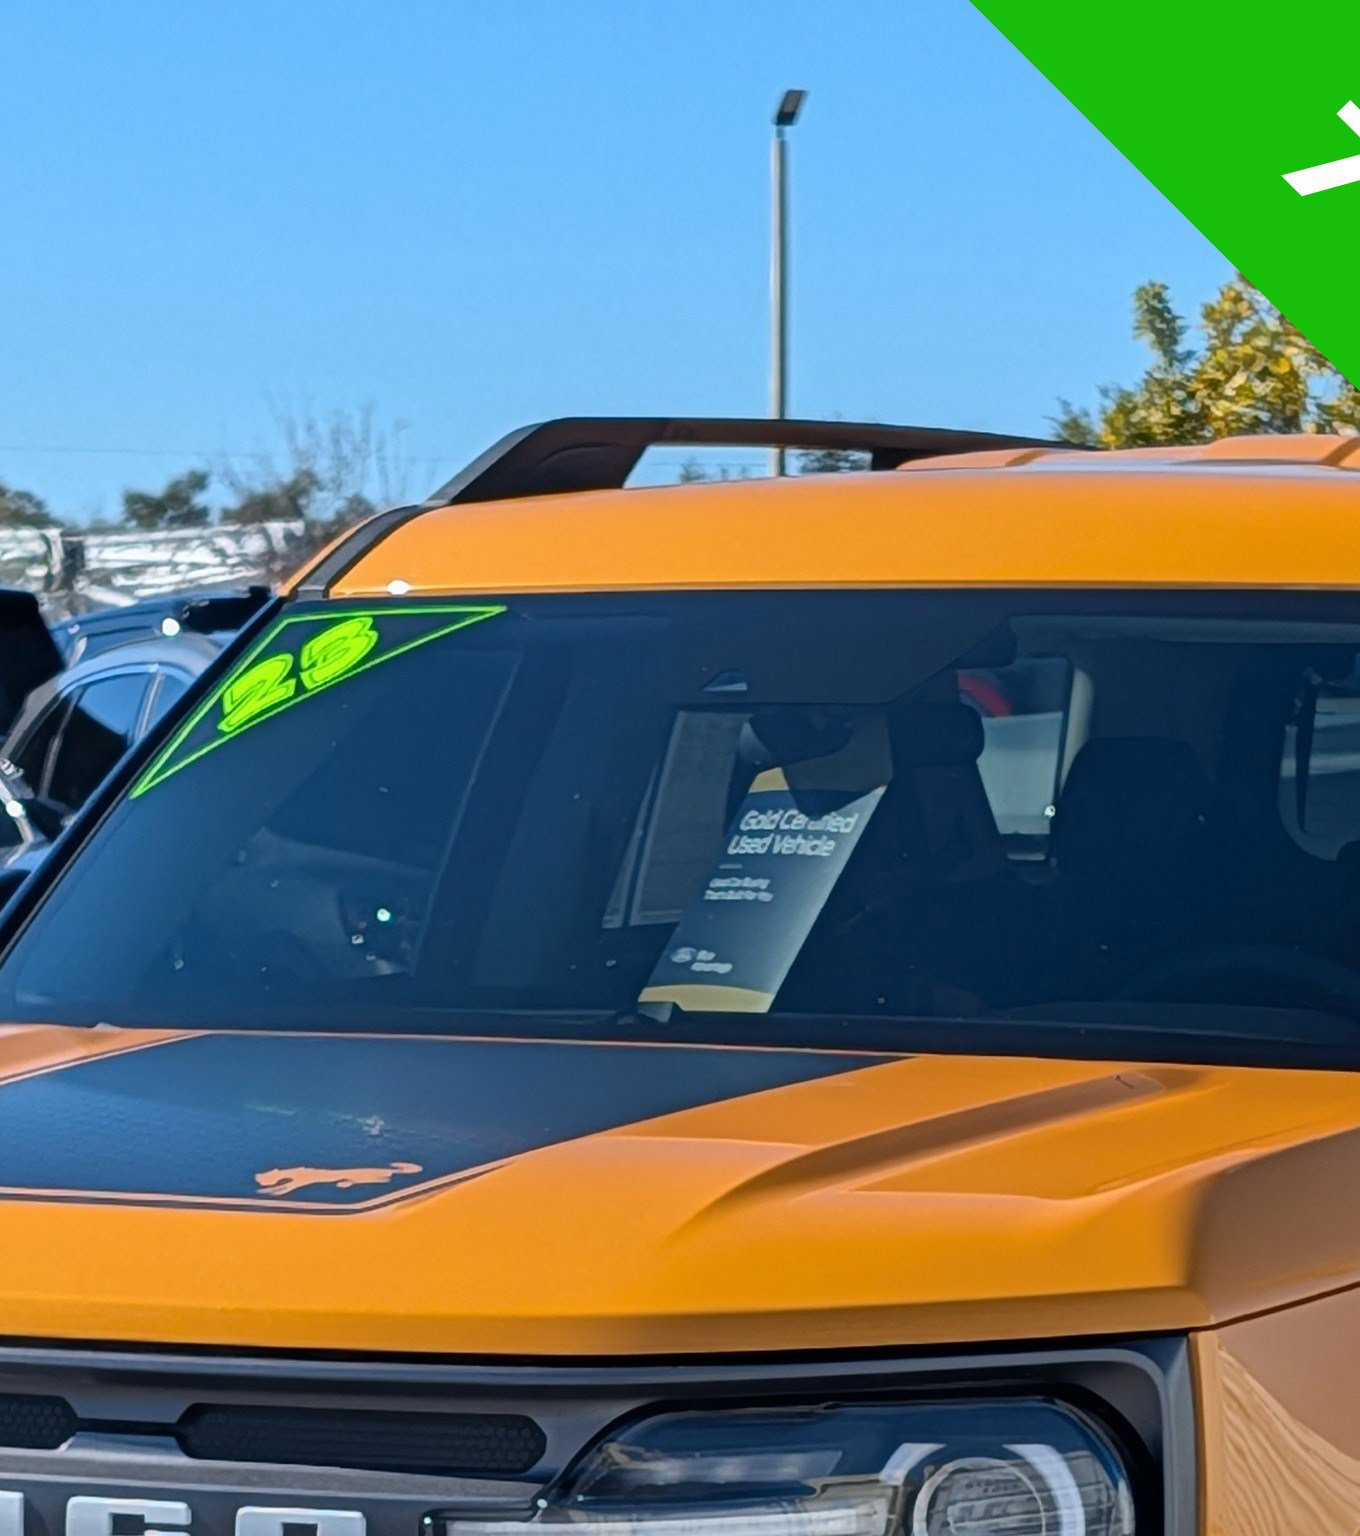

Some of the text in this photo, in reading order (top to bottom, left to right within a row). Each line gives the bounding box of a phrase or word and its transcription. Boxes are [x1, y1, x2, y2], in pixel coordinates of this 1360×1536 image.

[740, 809, 784, 831] Gold
[727, 833, 836, 857] Used Vehicle
